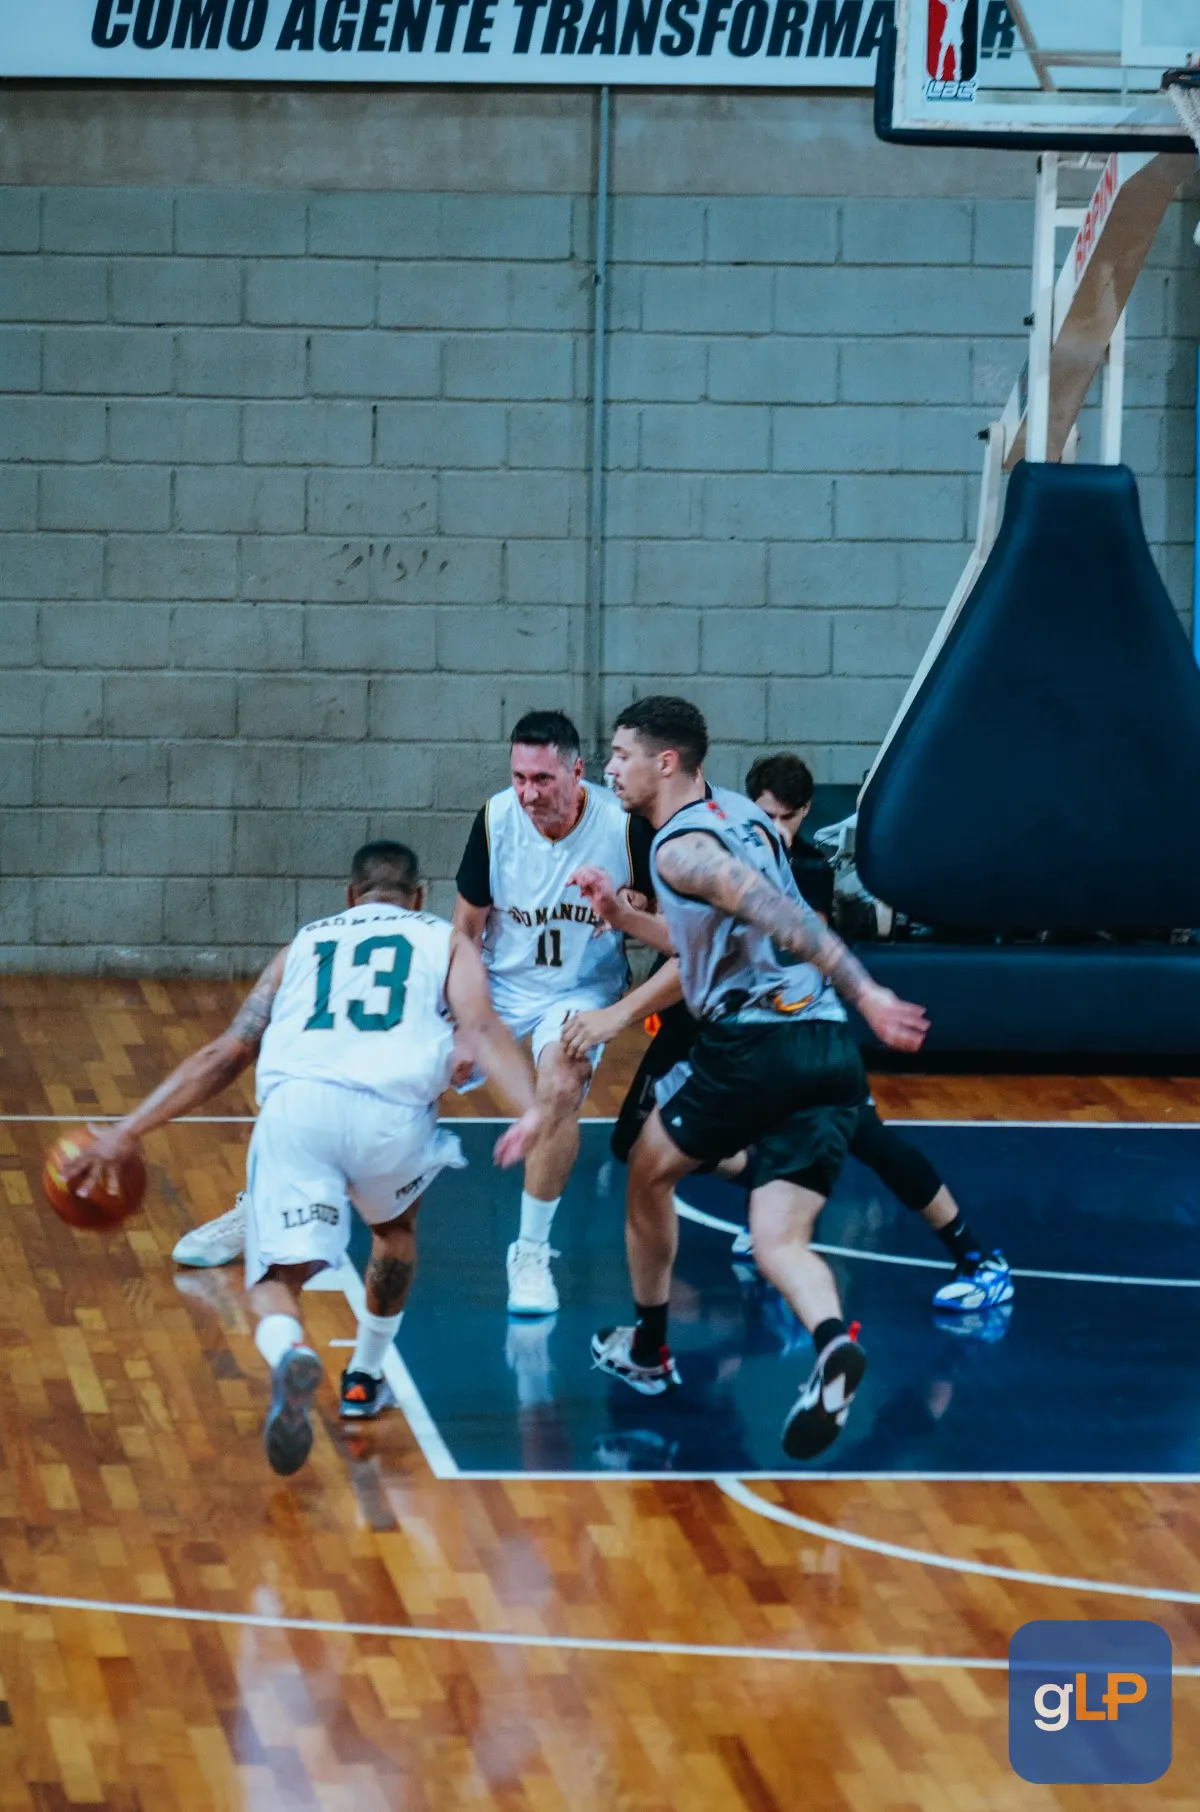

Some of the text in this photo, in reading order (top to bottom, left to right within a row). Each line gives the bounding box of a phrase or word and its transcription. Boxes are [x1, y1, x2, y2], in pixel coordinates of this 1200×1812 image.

[91, 0, 269, 50] COMO
[275, 0, 497, 53] AGENTE
[535, 929, 563, 967] 11
[303, 933, 414, 1033] 13
